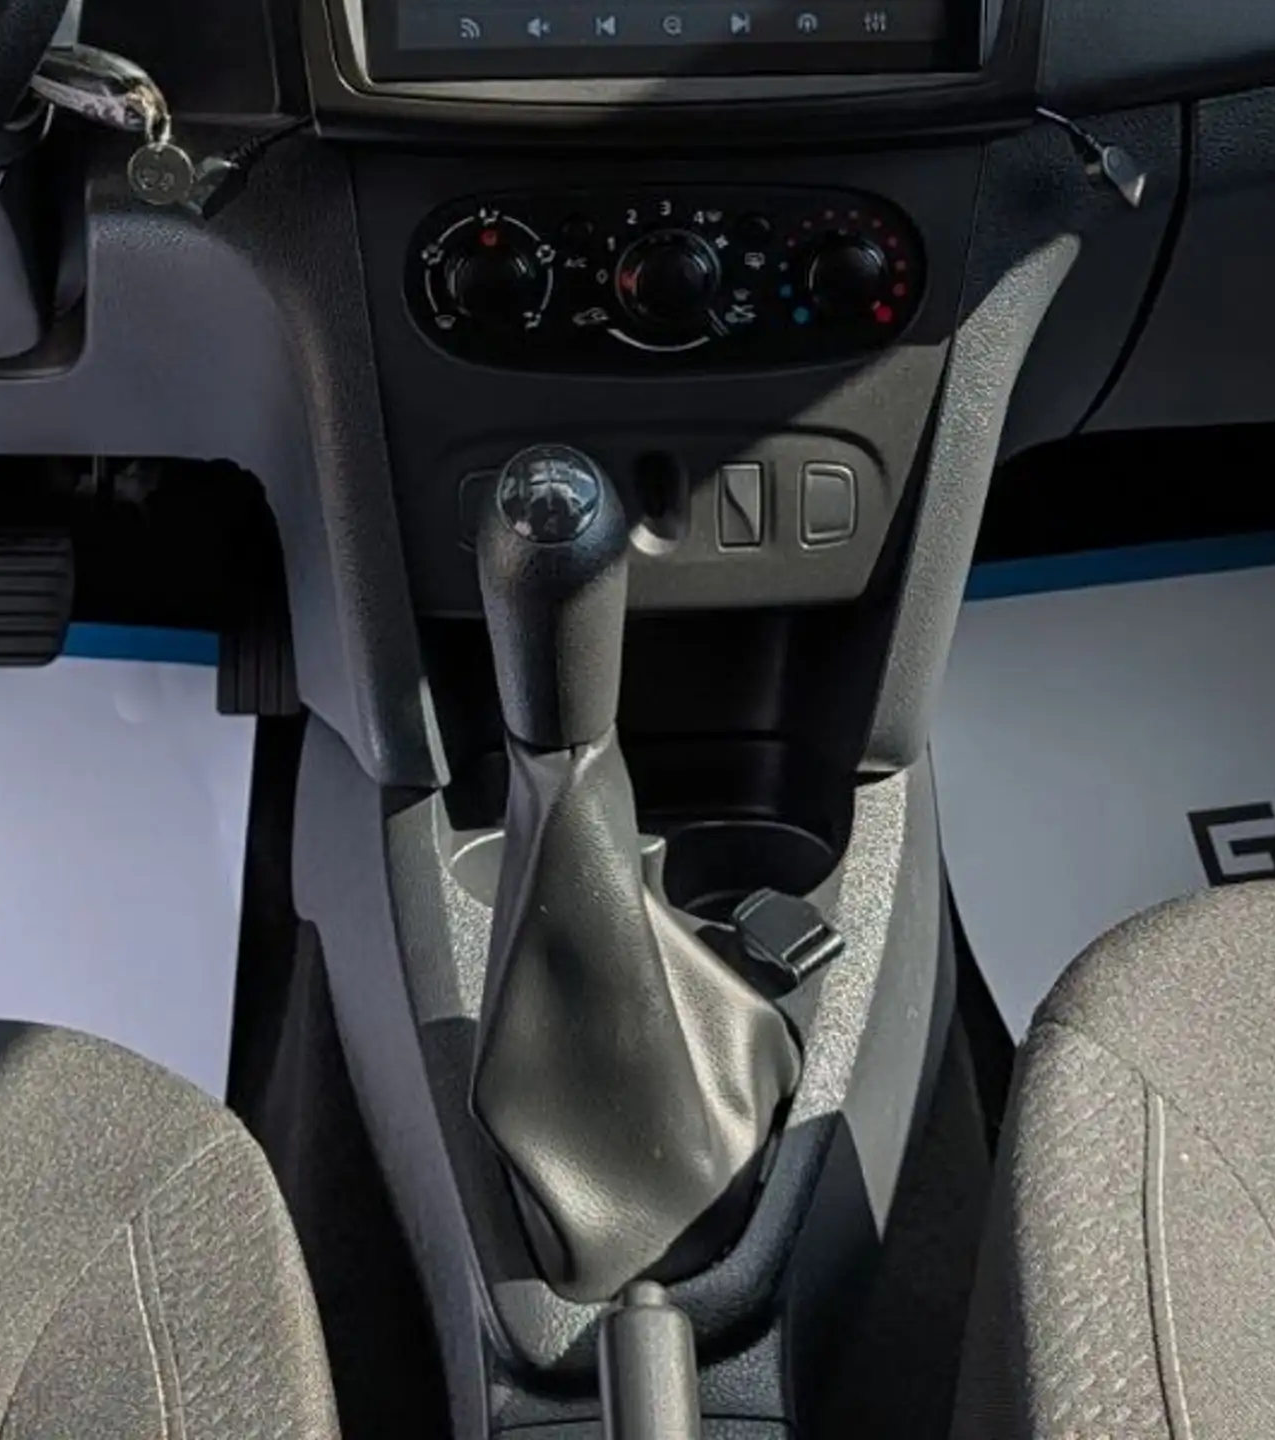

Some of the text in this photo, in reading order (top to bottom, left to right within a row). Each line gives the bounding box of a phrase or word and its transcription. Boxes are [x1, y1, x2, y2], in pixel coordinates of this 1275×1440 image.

[659, 200, 672, 216] 3
[626, 209, 638, 225] 2
[693, 210, 705, 224] 4
